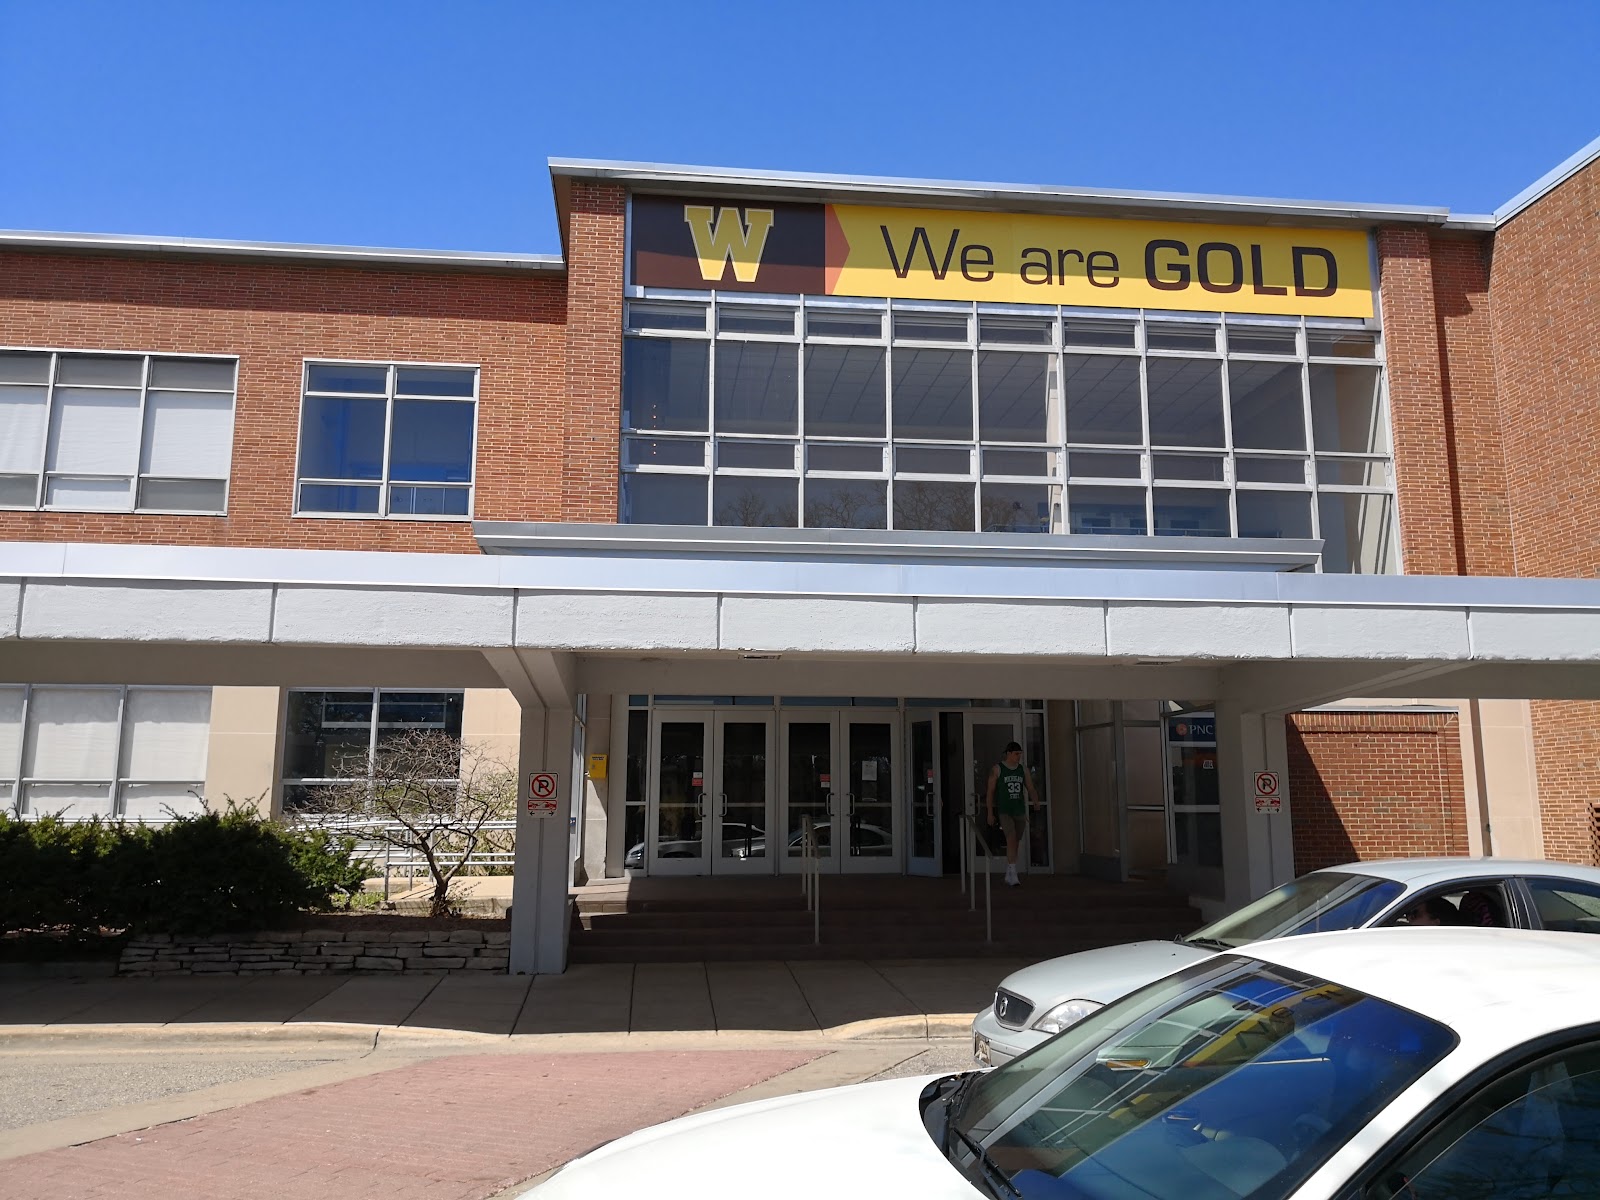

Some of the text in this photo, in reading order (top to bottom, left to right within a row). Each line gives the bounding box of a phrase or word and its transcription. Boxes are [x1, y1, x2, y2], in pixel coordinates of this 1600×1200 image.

[683, 204, 774, 283] W
[879, 224, 1339, 298] We are GOLD
[1189, 724, 1214, 735] PNC
[1007, 782, 1021, 793] 33
